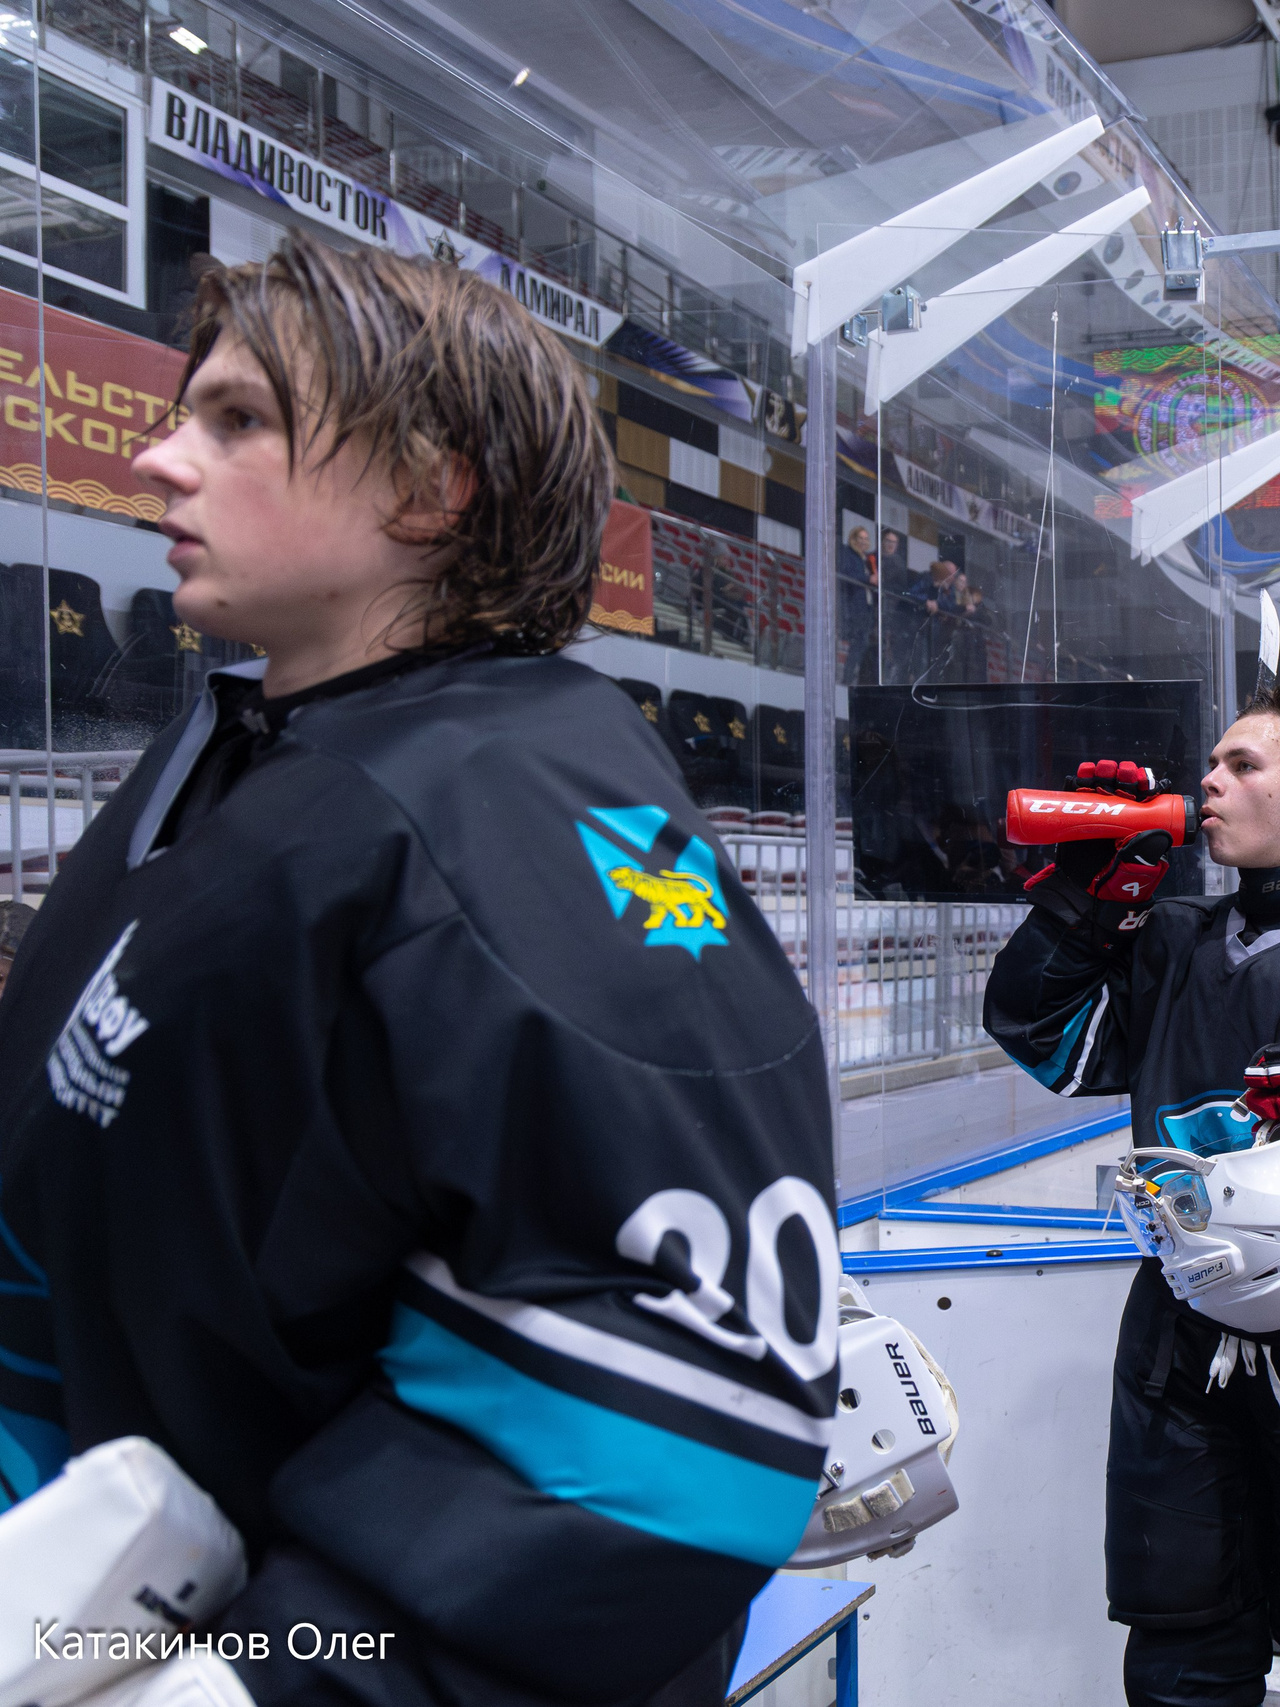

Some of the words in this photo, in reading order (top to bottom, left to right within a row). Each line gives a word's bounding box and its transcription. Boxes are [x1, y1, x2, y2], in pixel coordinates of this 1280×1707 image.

[165, 91, 388, 241] ВЛАДИВОСТОК
[4, 394, 164, 460] СКОГ
[1029, 800, 1126, 816] CCM
[615, 1175, 840, 1382] 20
[885, 1342, 937, 1435] BAUER
